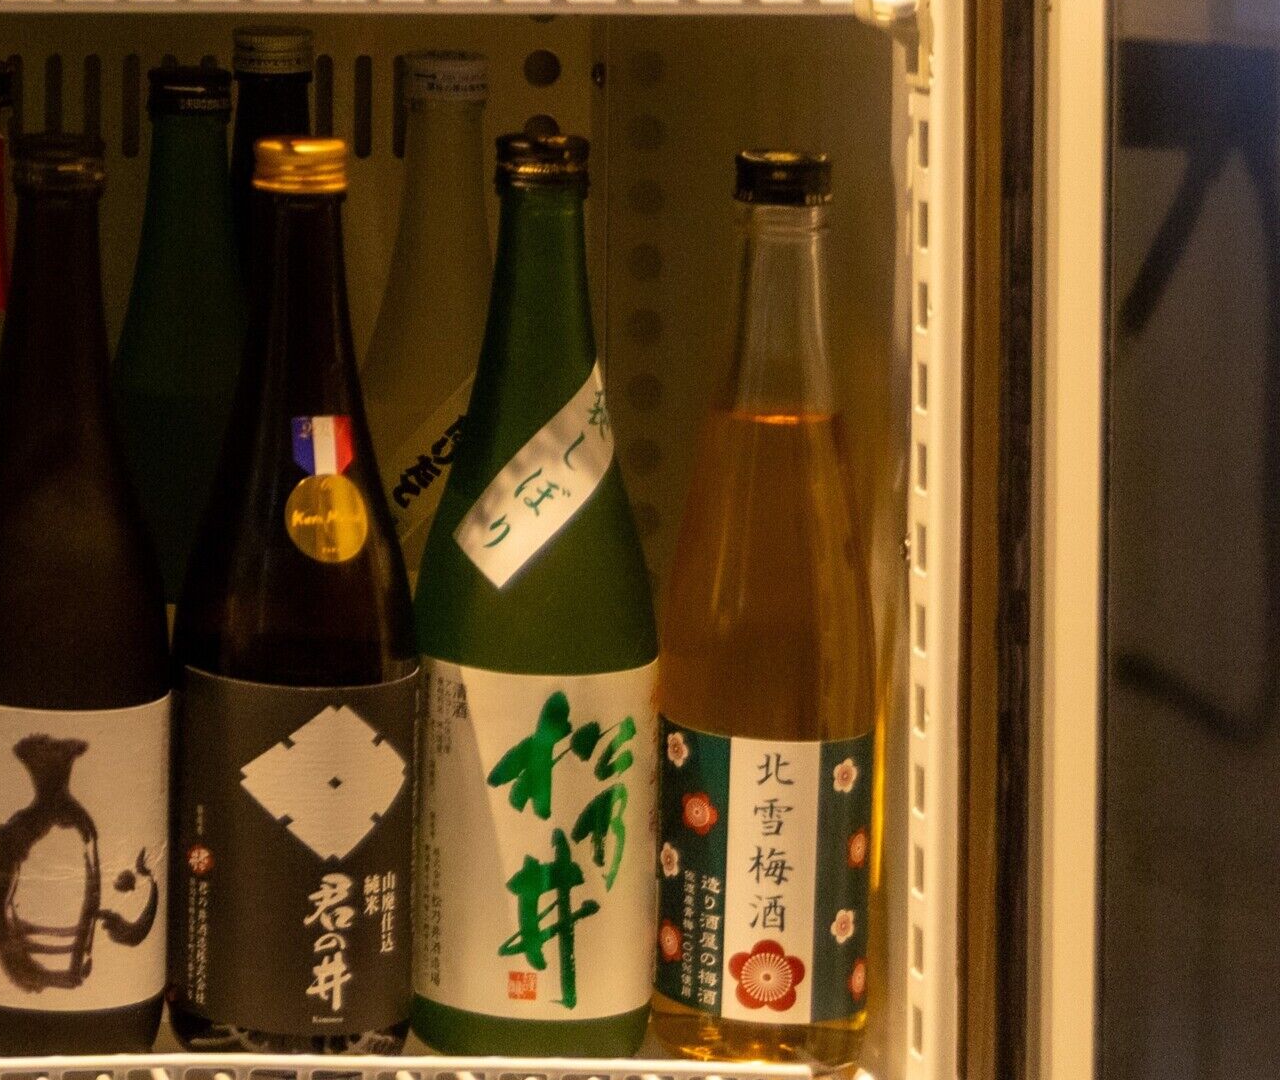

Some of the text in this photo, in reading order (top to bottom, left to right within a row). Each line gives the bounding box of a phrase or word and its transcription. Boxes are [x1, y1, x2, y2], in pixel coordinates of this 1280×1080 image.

[749, 753, 794, 933] 北雪梅酒
[303, 872, 356, 1012] 君の井
[698, 874, 721, 1006] 造り酒屋の梅酒
